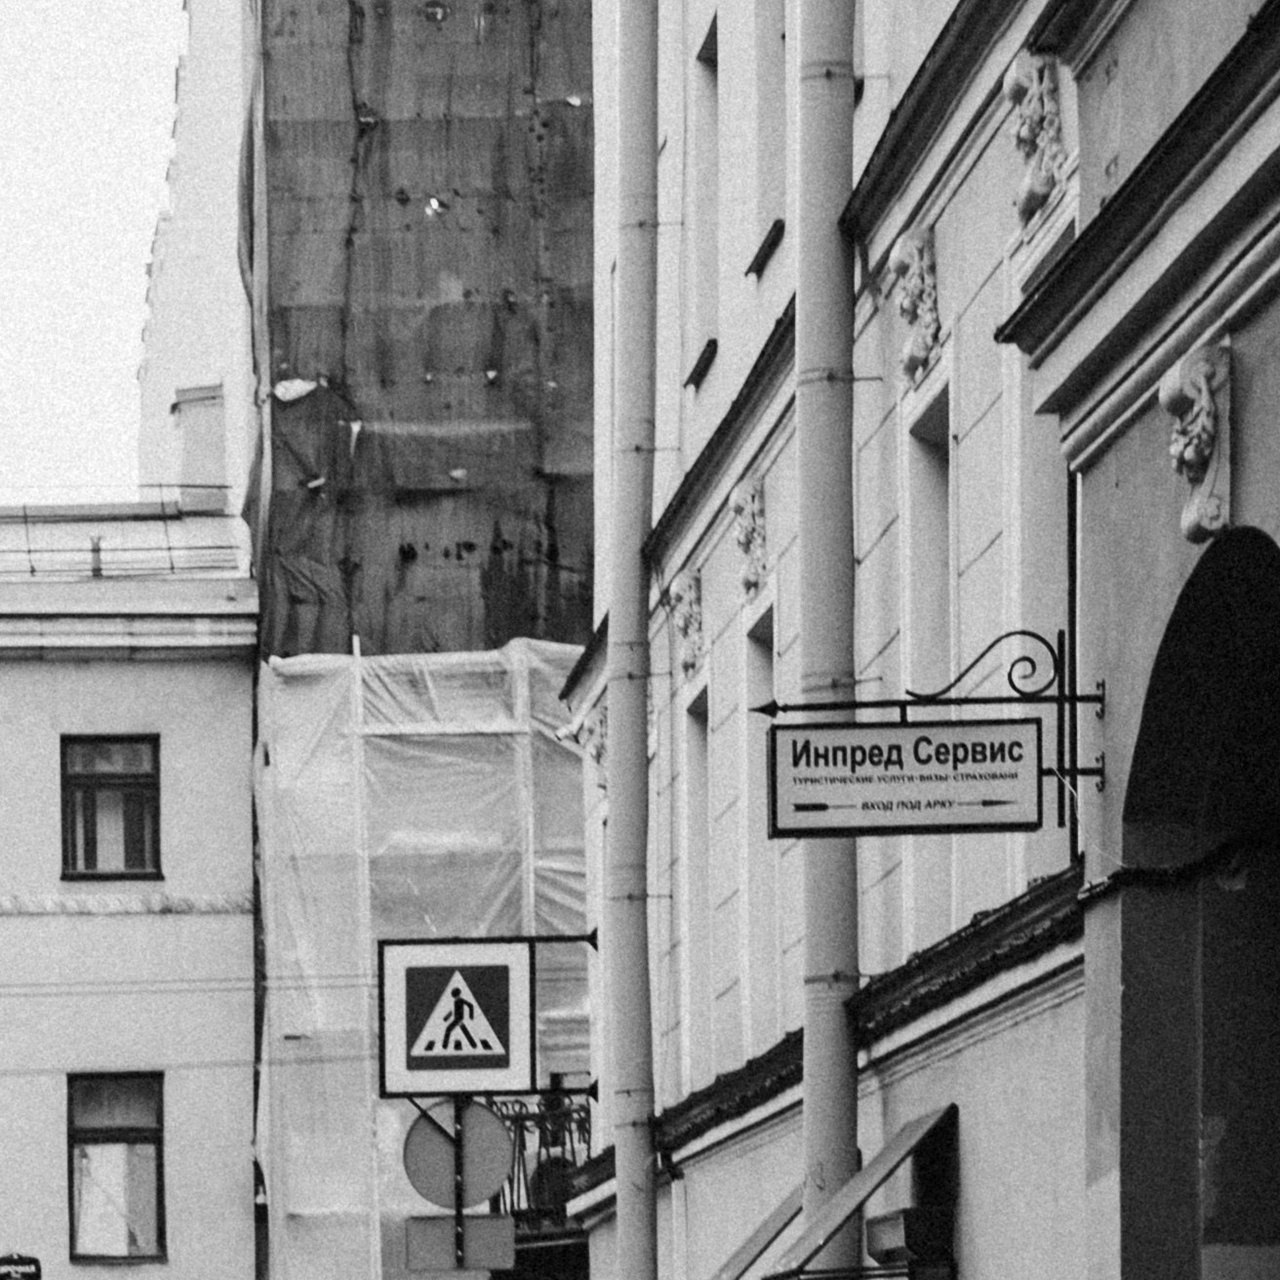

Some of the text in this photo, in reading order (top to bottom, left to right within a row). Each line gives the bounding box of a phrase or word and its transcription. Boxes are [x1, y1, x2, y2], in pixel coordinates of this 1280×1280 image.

[791, 736, 1024, 773] Инпред Сервис
[861, 799, 956, 812] ВХОД ПОД АРКУ
